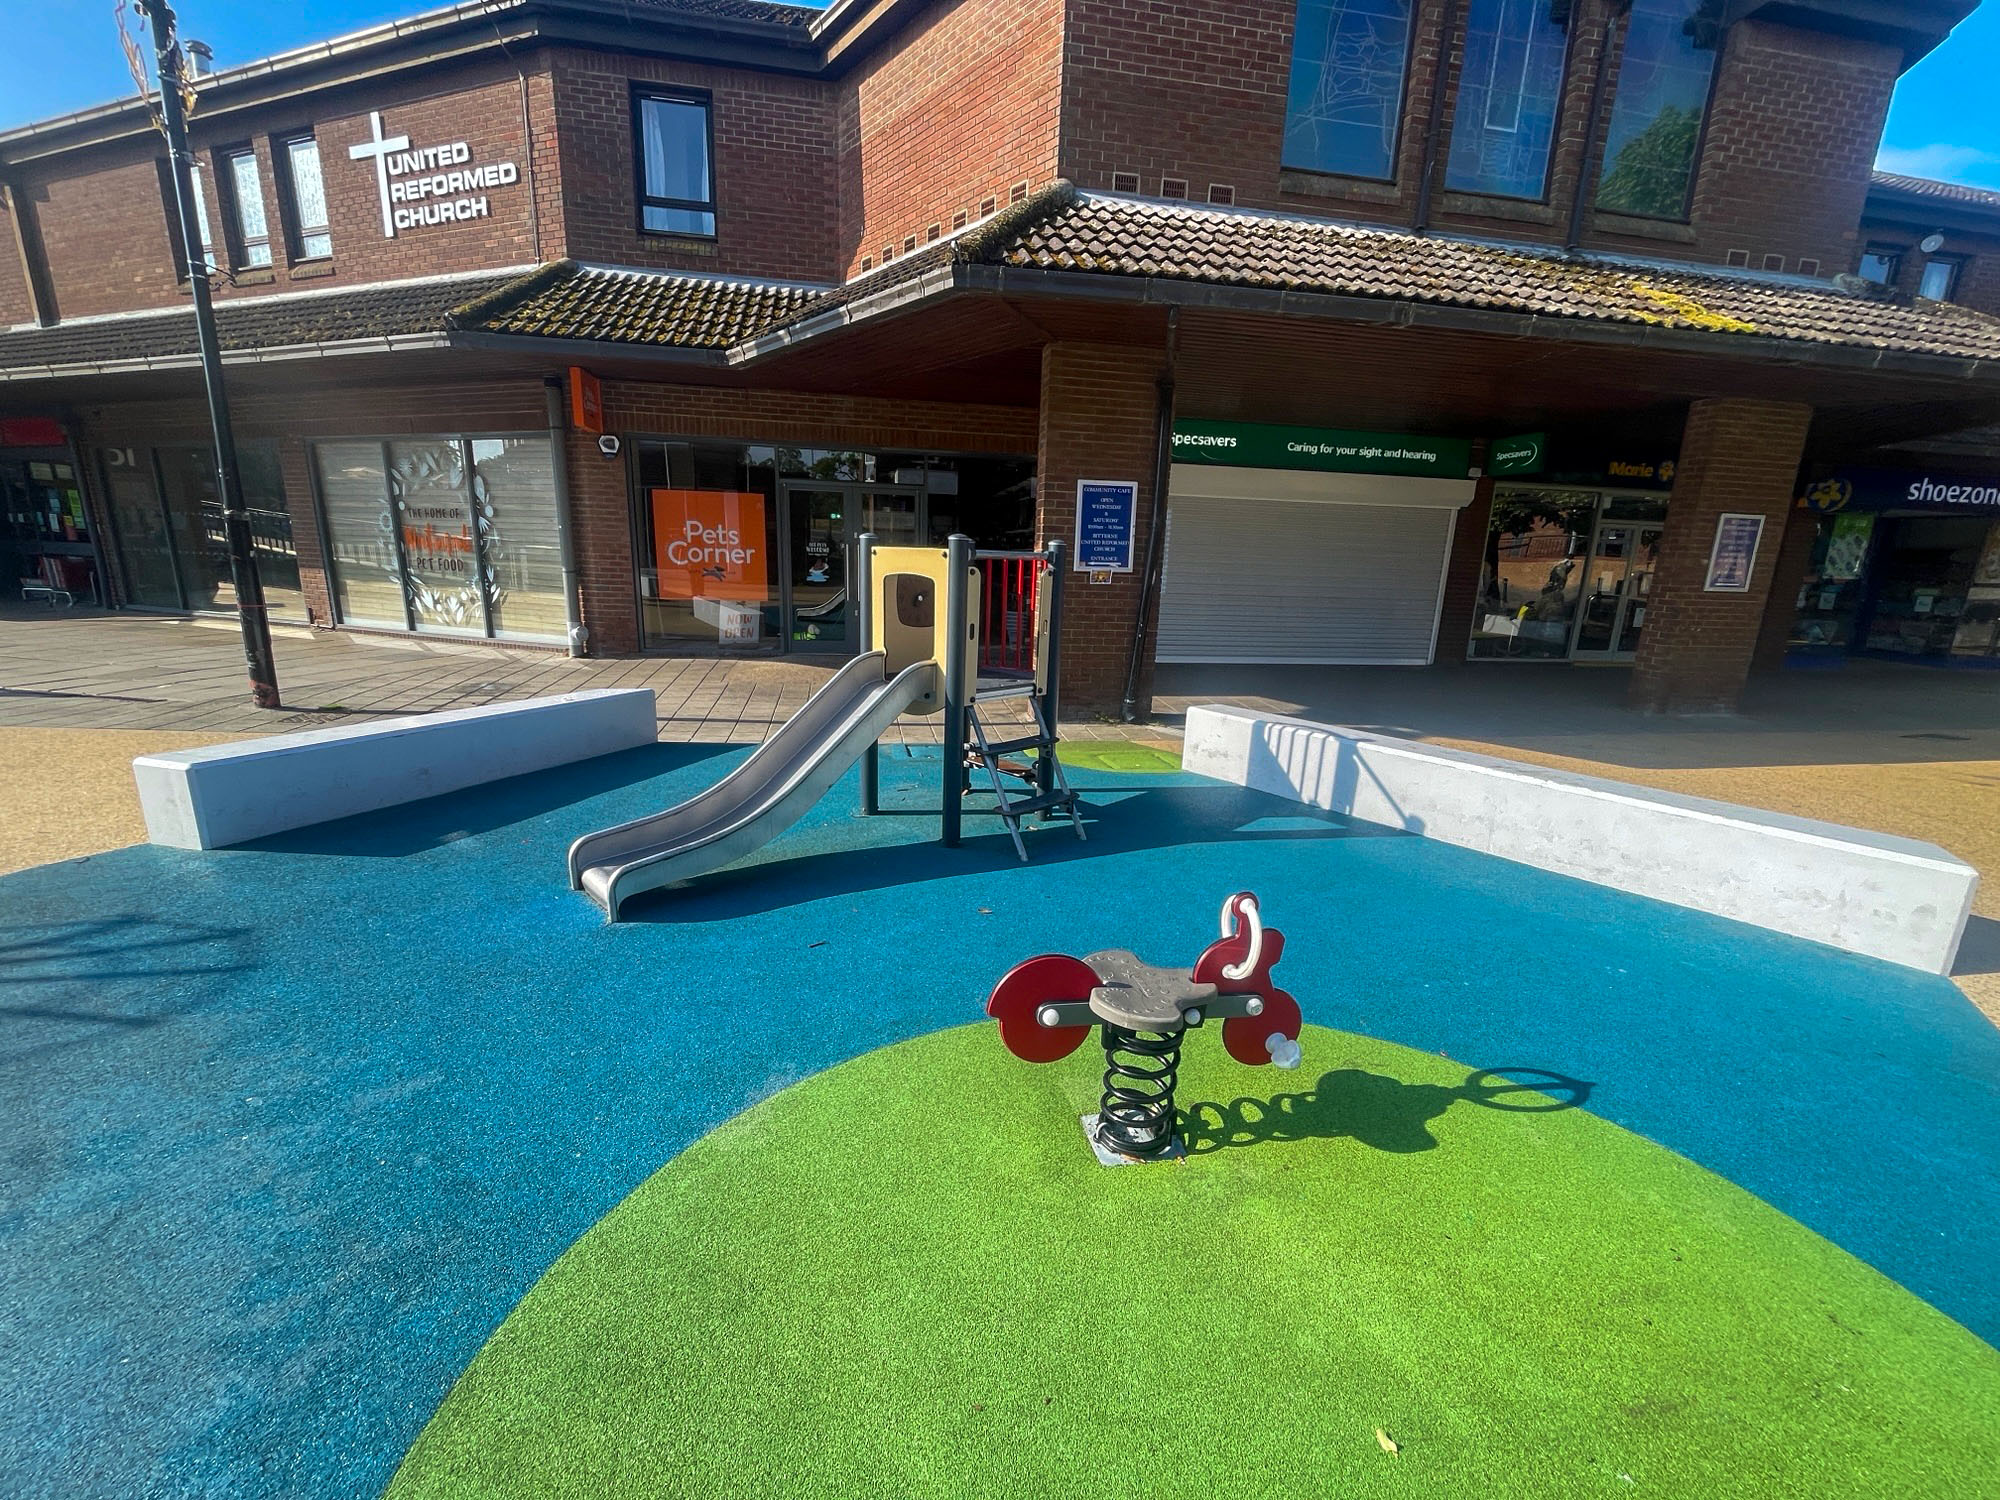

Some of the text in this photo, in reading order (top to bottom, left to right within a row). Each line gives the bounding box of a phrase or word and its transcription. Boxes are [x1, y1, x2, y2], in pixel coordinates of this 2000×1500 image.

[387, 142, 469, 176] UNITED
[390, 162, 517, 203] REFORMED
[394, 196, 488, 229] CHURCH
[1287, 441, 1437, 463] Caring for your sight and hearing
[1496, 449, 1532, 461] Specsavers
[1608, 460, 1654, 477] Marie
[1083, 486, 1117, 494] COMMUNITY
[1907, 477, 2000, 506] shoezon
[408, 508, 461, 519] THE HOME OF
[685, 520, 740, 545] Pets
[668, 540, 756, 566] Corner
[416, 557, 464, 572] PET FOOD
[727, 613, 753, 626] NOW
[724, 627, 754, 639] OPEN
